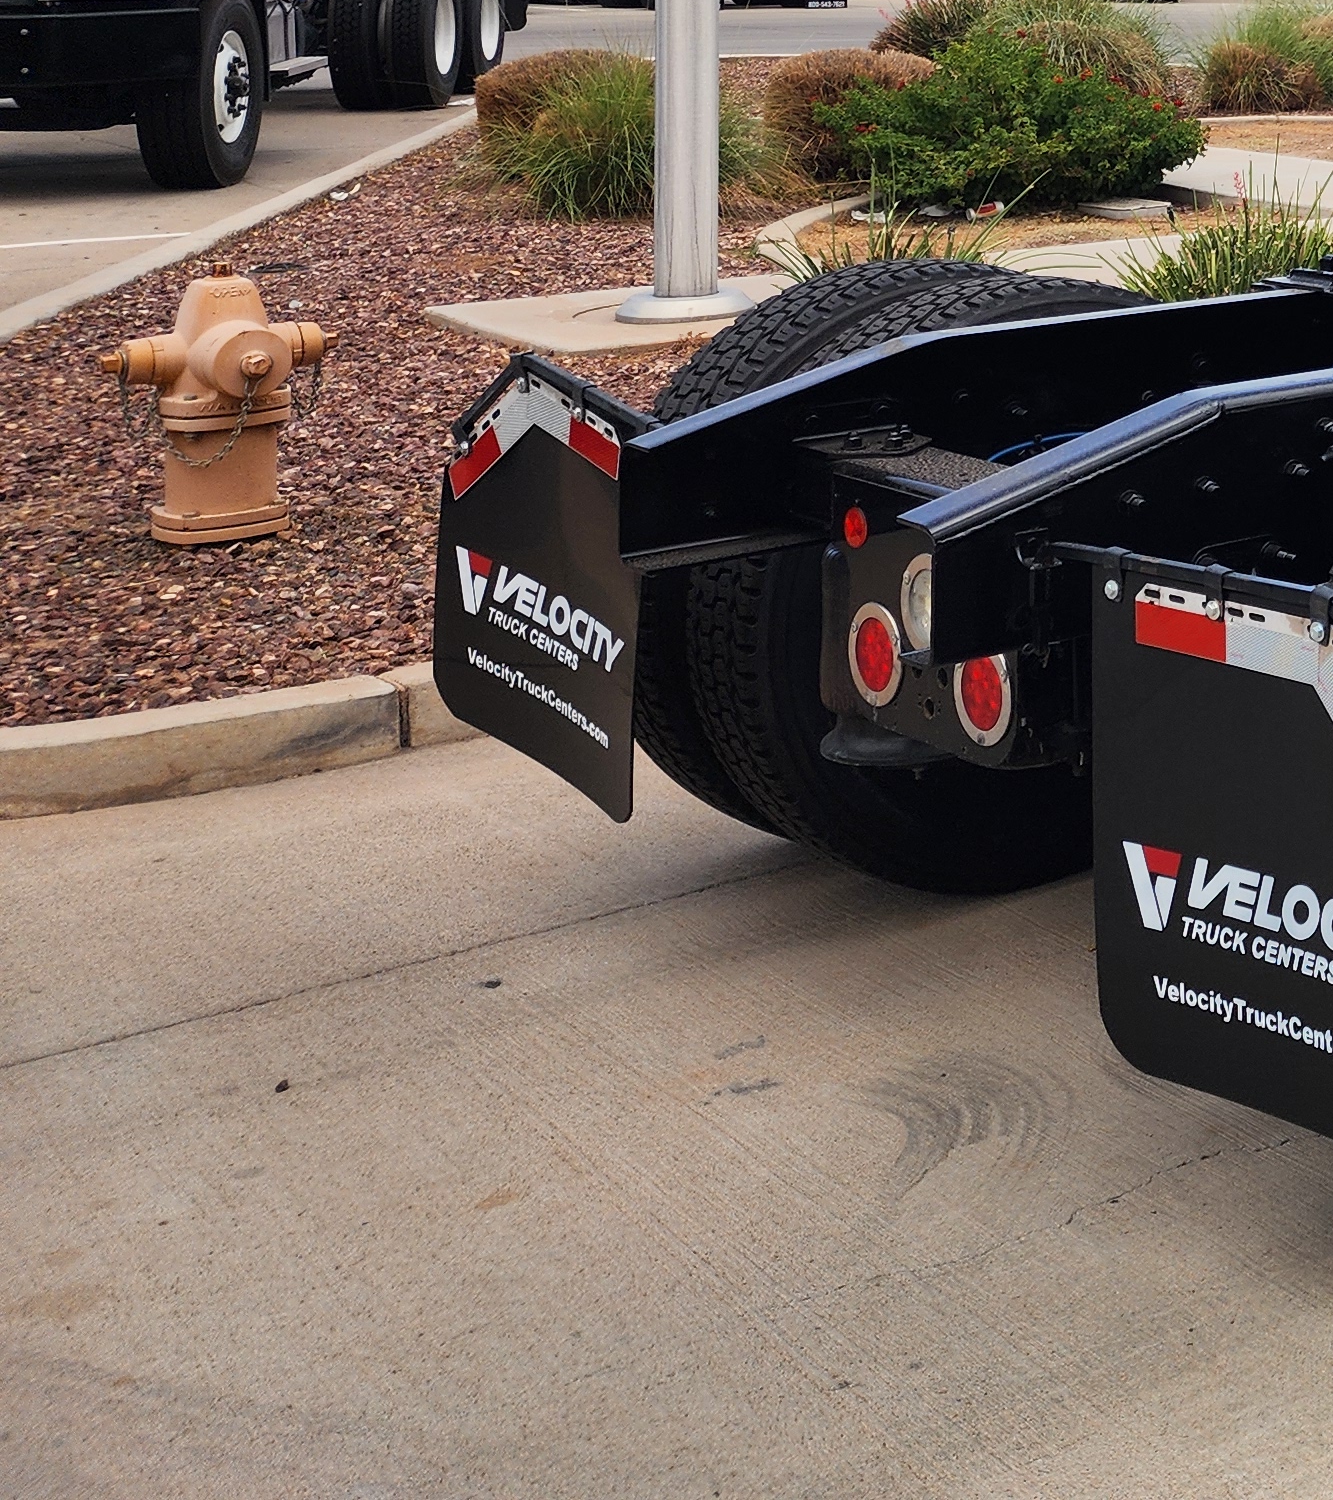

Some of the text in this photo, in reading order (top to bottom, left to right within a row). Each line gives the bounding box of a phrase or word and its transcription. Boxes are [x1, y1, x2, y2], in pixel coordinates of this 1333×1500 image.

[487, 606, 579, 671] TRUCK CENTERS
[493, 565, 625, 673] VELOCITY
[467, 646, 609, 749] VelocityTruckCenters.com
[1181, 916, 1249, 955] TRUCK
